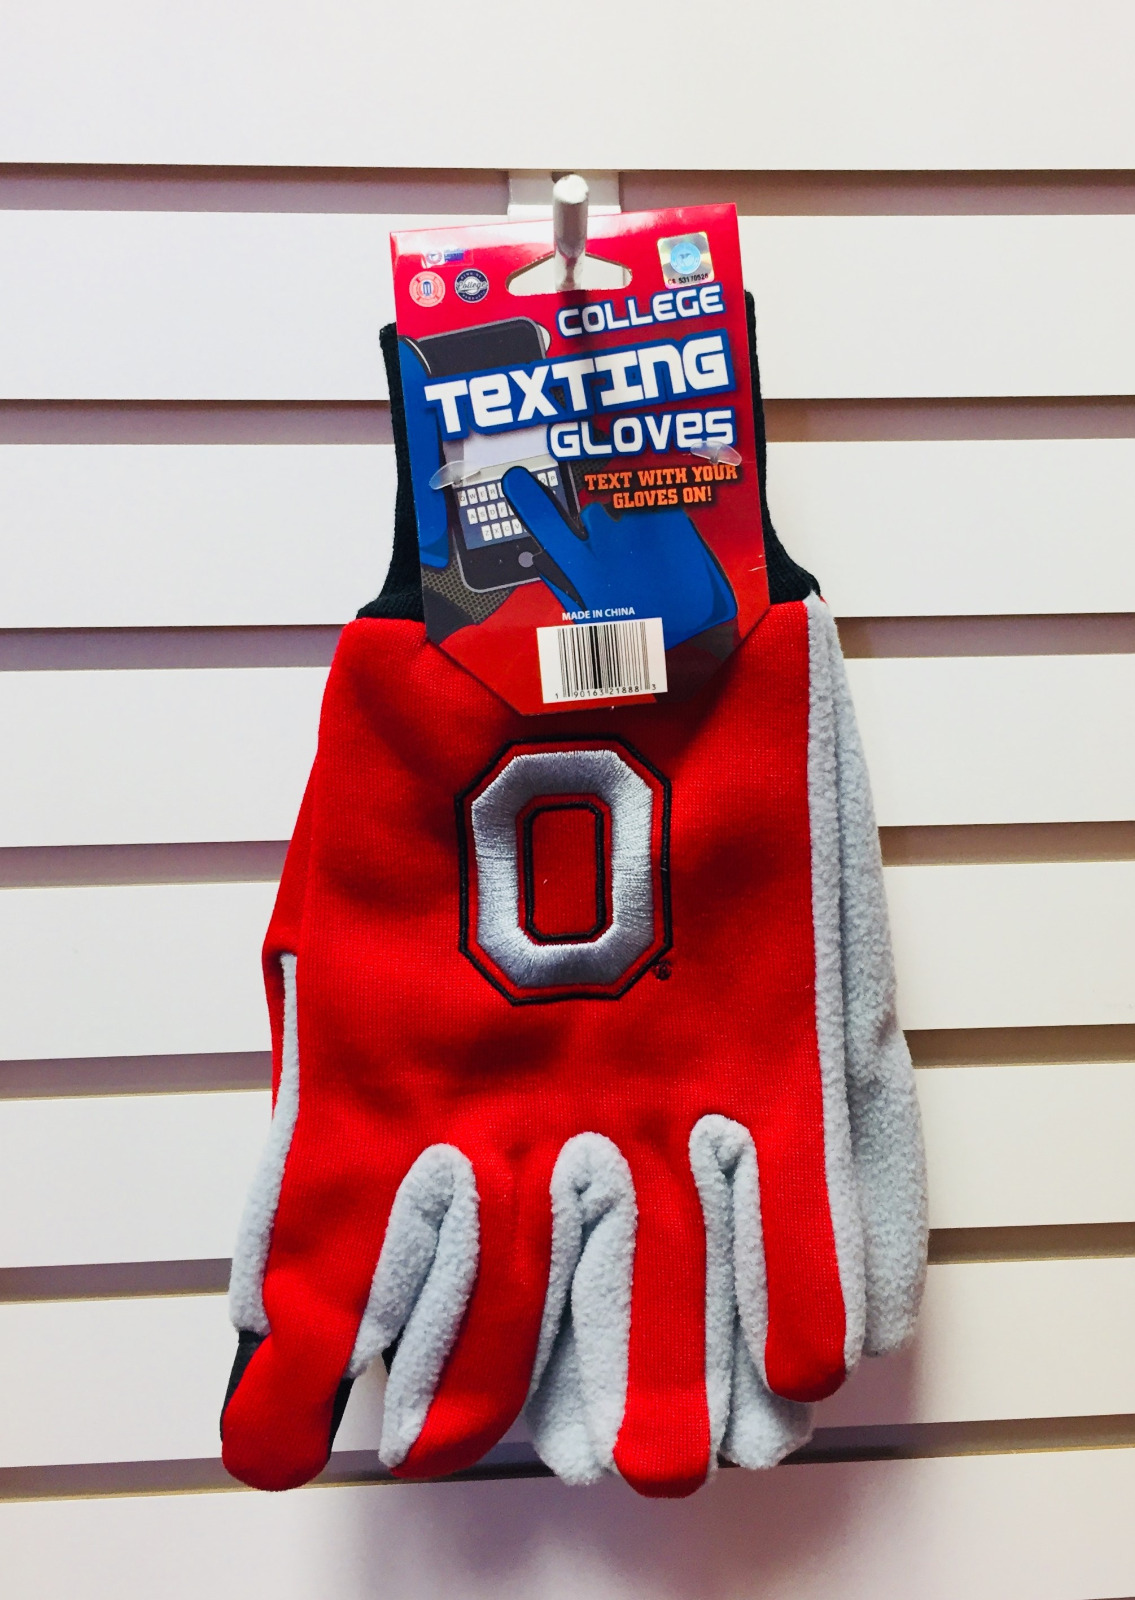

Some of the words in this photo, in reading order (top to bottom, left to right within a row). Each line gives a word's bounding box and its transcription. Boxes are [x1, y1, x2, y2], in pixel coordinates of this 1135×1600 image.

[557, 285, 724, 337] COLLEGE
[584, 471, 633, 491] TEXT
[638, 467, 687, 487] WITH
[691, 464, 738, 482] YOUR
[612, 489, 678, 509] GLOVES
[682, 485, 712, 503] ON!
[561, 610, 591, 621] MADE
[592, 609, 603, 618] IN
[604, 606, 636, 617] CHINA
[573, 690, 604, 698] 90163
[609, 685, 640, 695] 21888
